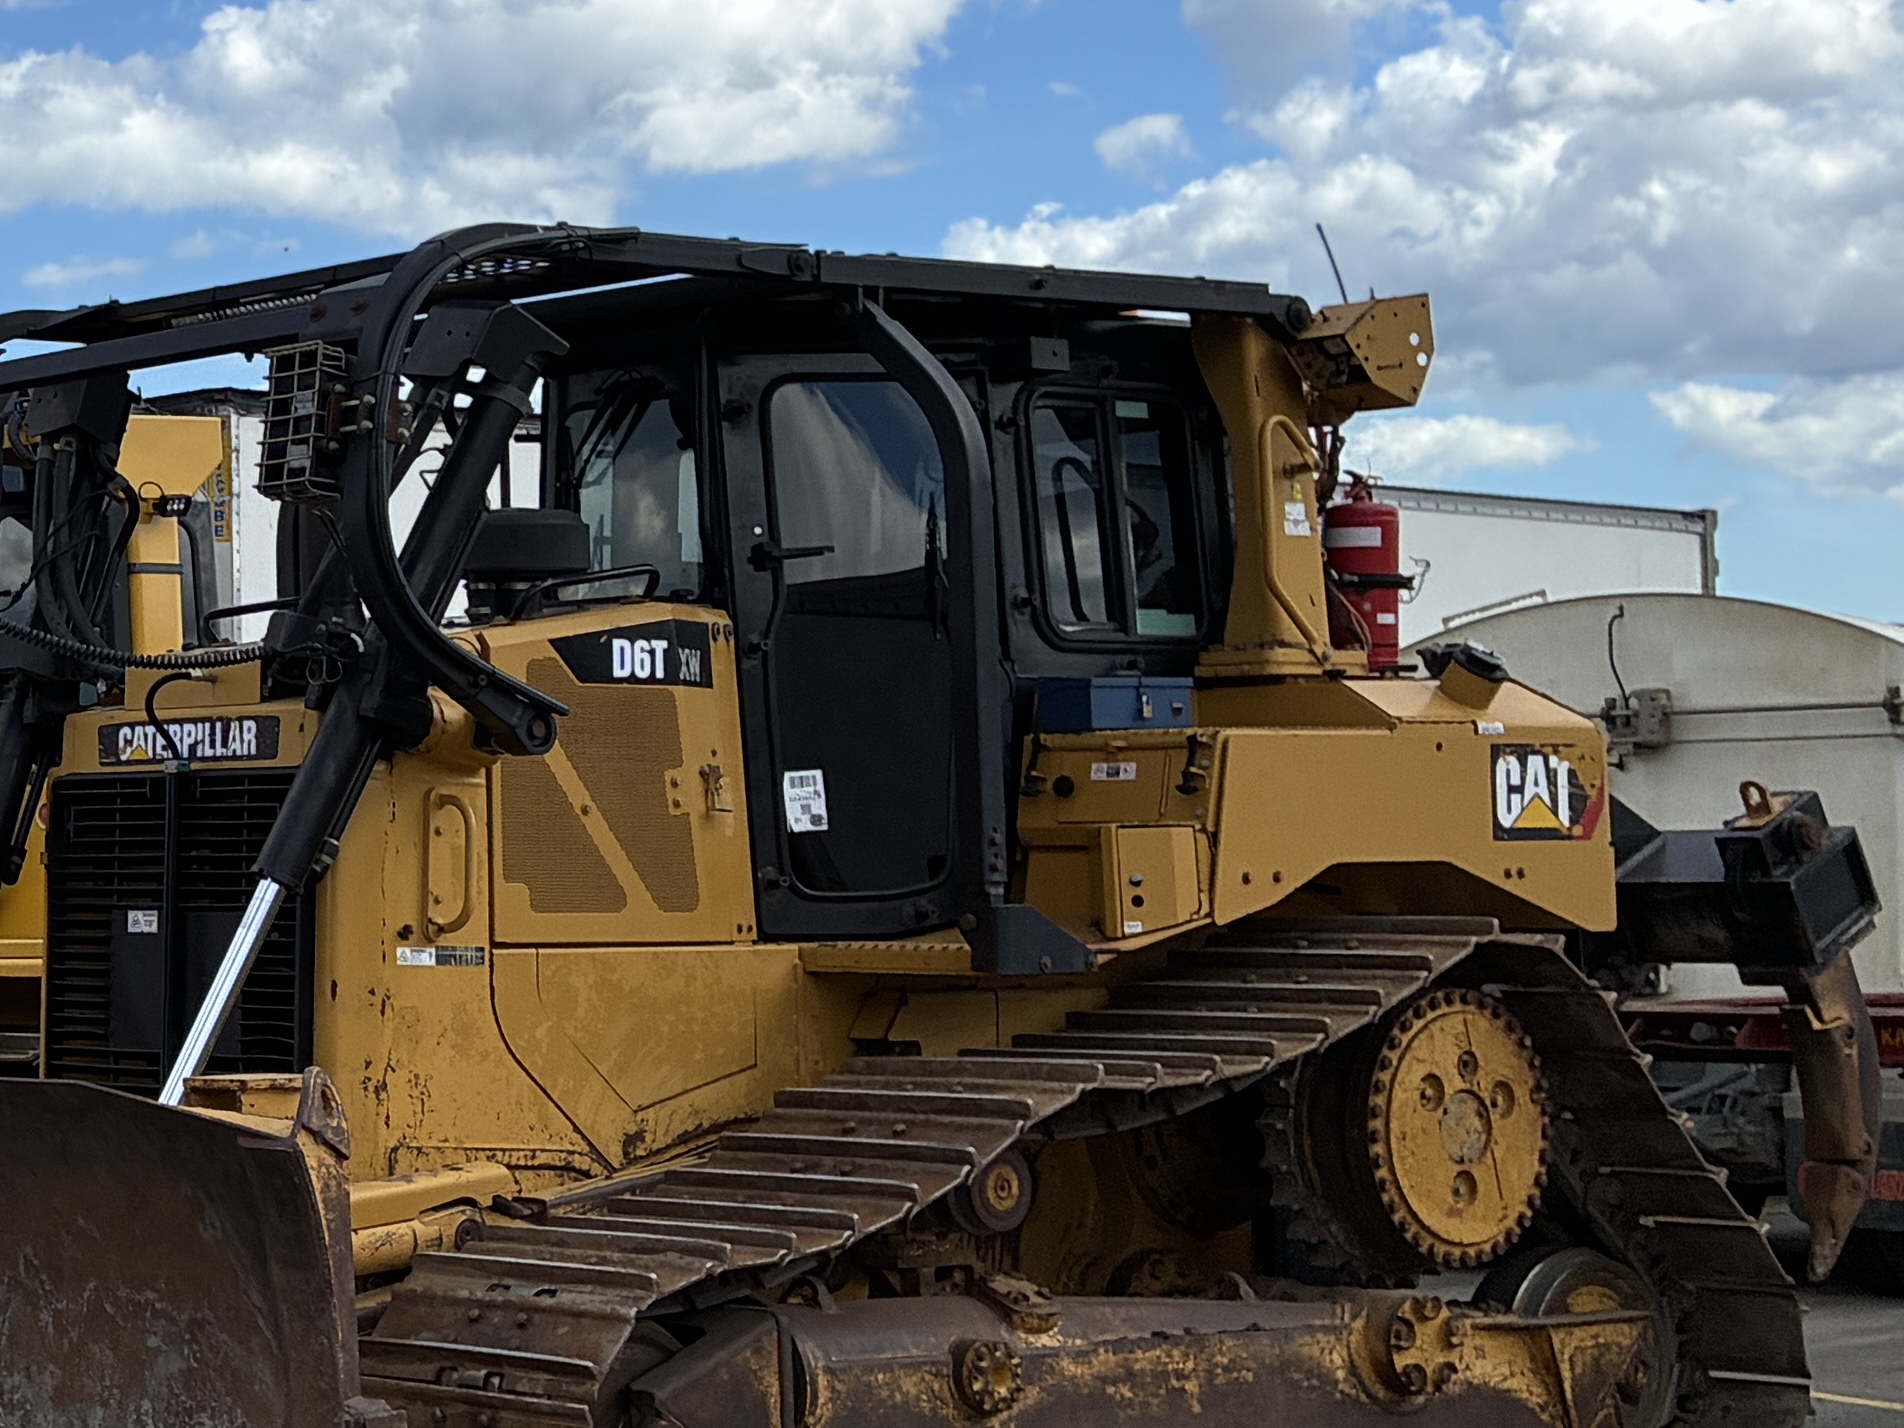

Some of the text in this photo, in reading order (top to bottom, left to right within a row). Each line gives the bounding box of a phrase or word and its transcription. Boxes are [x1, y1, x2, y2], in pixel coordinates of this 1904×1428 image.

[612, 638, 701, 682] D6T XW
[1496, 754, 1570, 829] CAT
